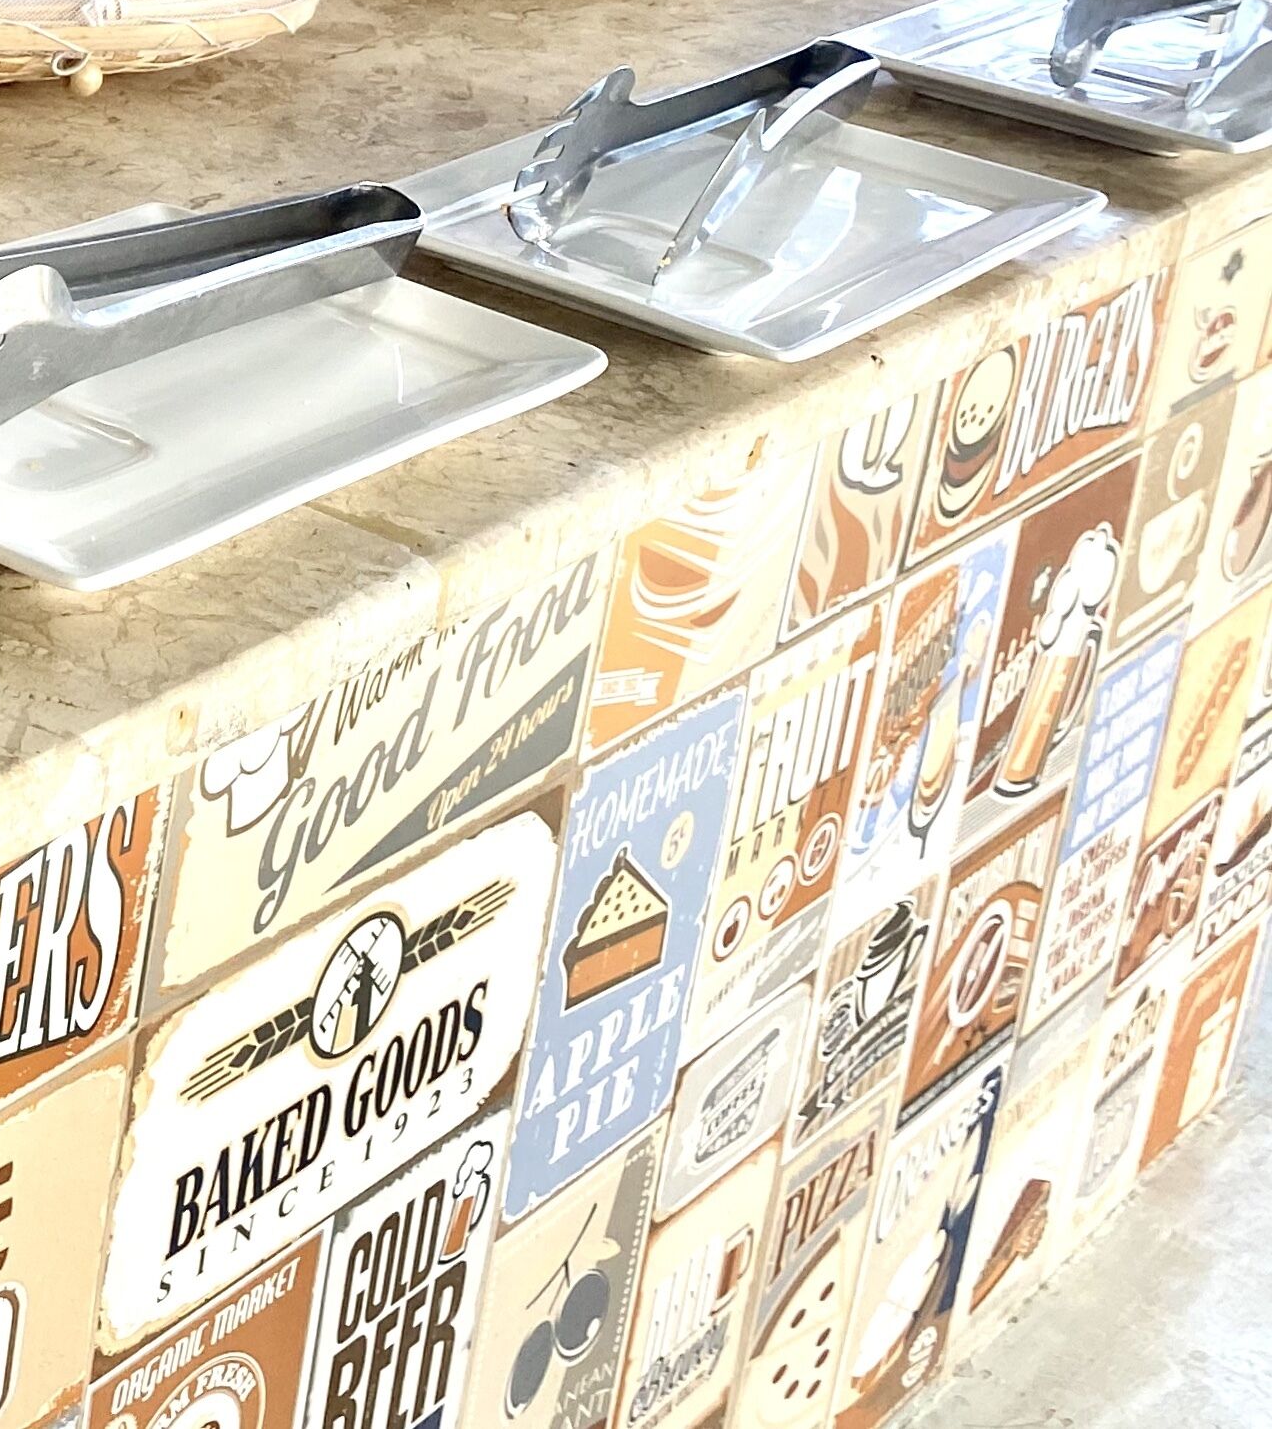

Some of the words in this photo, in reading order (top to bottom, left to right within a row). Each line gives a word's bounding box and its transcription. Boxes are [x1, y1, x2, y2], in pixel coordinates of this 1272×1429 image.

[254, 664, 443, 935] Good
[426, 764, 483, 831] Open
[484, 723, 515, 777] 24
[515, 674, 576, 749] hours
[568, 720, 735, 869] HOMEMADE
[731, 651, 876, 846] FRUIT
[164, 1083, 333, 1262] BAKED
[343, 979, 489, 1138] GOODS
[523, 964, 686, 1120] APPLE
[548, 1055, 640, 1165] PIE
[156, 1158, 336, 1303] SINCE
[362, 1066, 474, 1163] 1923
[336, 1178, 446, 1345] COLD
[768, 1129, 877, 1285] PIZZA
[111, 1320, 210, 1415] ORGANIC
[210, 1256, 301, 1346] MARKET
[194, 1361, 257, 1403] FRESH
[322, 1260, 467, 1429] BEER
